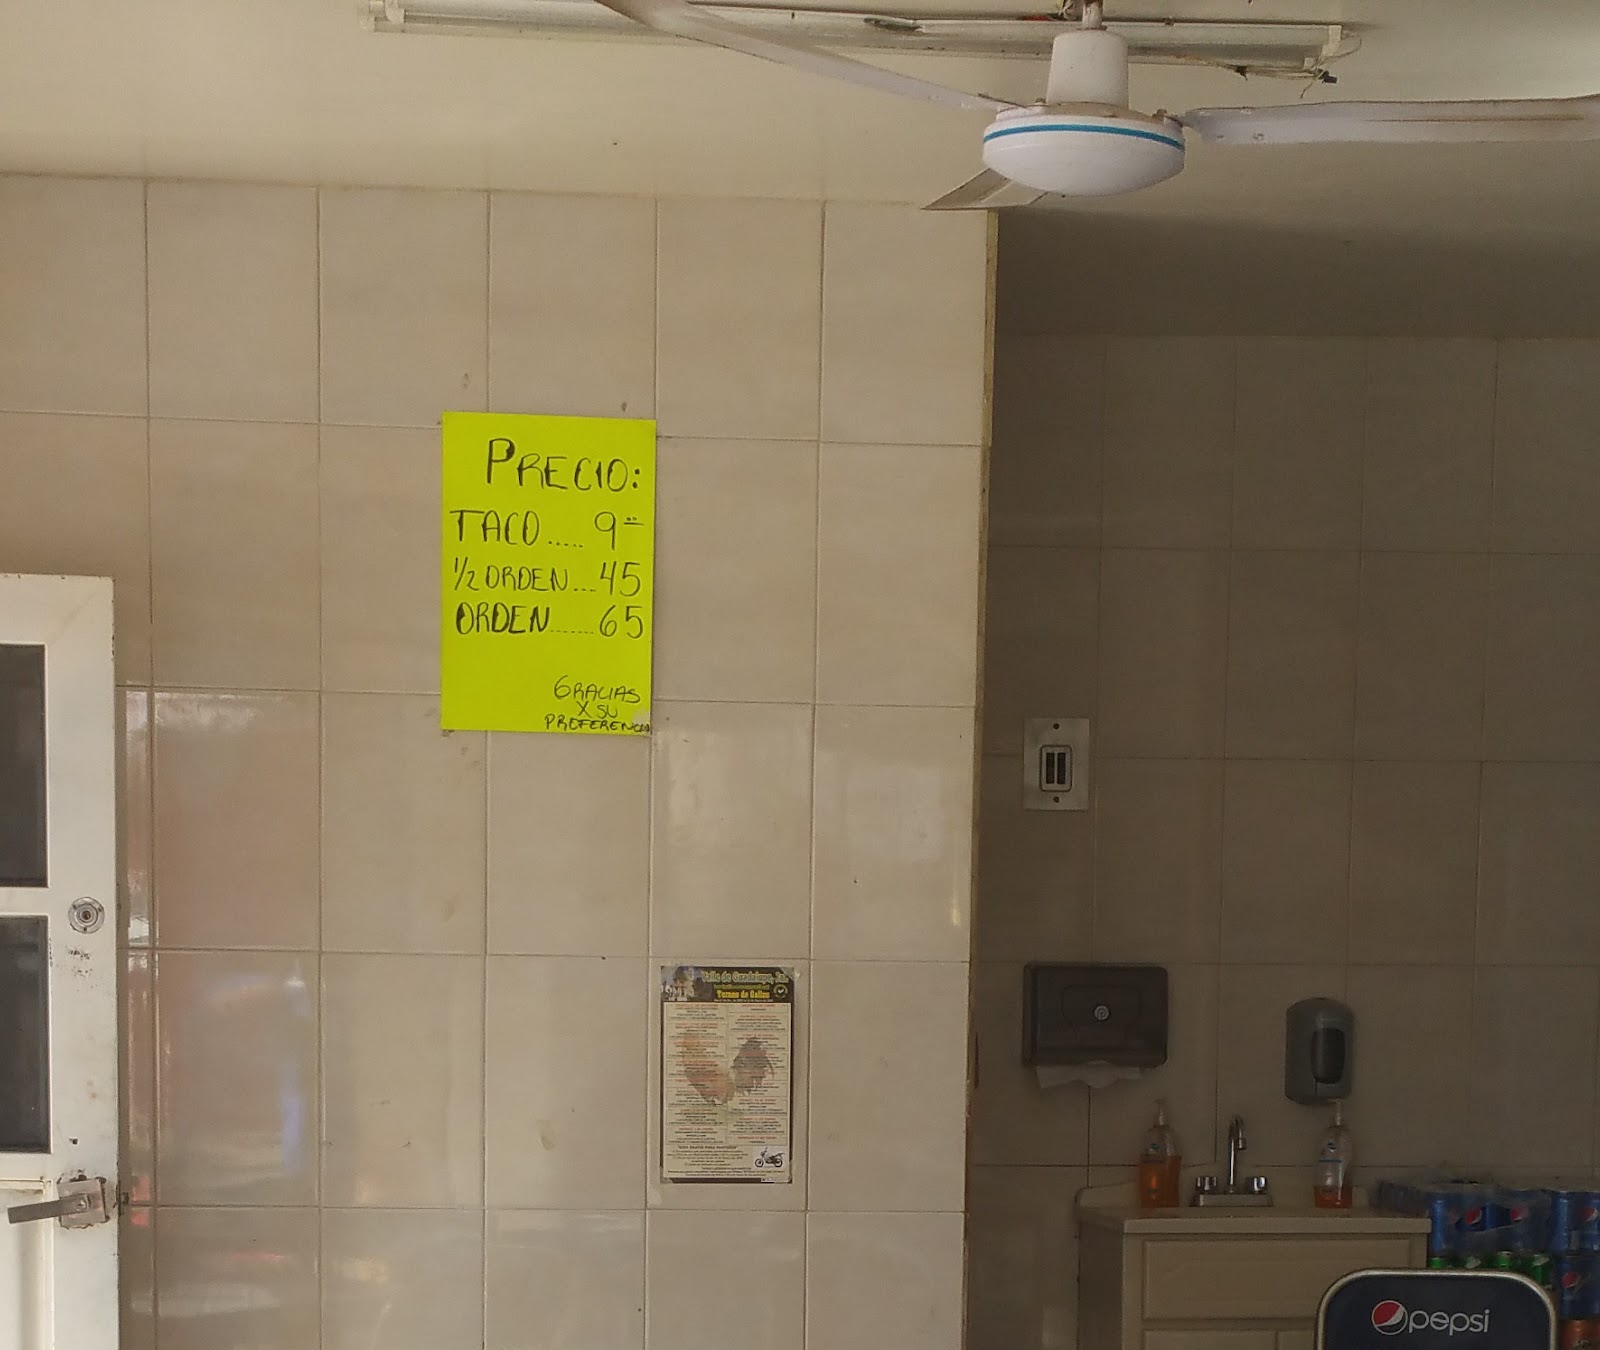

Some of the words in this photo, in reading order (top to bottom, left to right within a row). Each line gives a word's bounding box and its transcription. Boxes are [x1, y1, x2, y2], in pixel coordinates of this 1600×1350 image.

[486, 437, 640, 492] PRECIO:
[449, 509, 540, 546] TACO
[486, 565, 568, 592] ORDEN
[600, 561, 641, 597] 45
[456, 601, 550, 635] ORDEN
[599, 604, 644, 639] 65
[553, 674, 641, 704] GRACIAS
[597, 703, 618, 719] SU
[1409, 1309, 1490, 1337] pepsi
